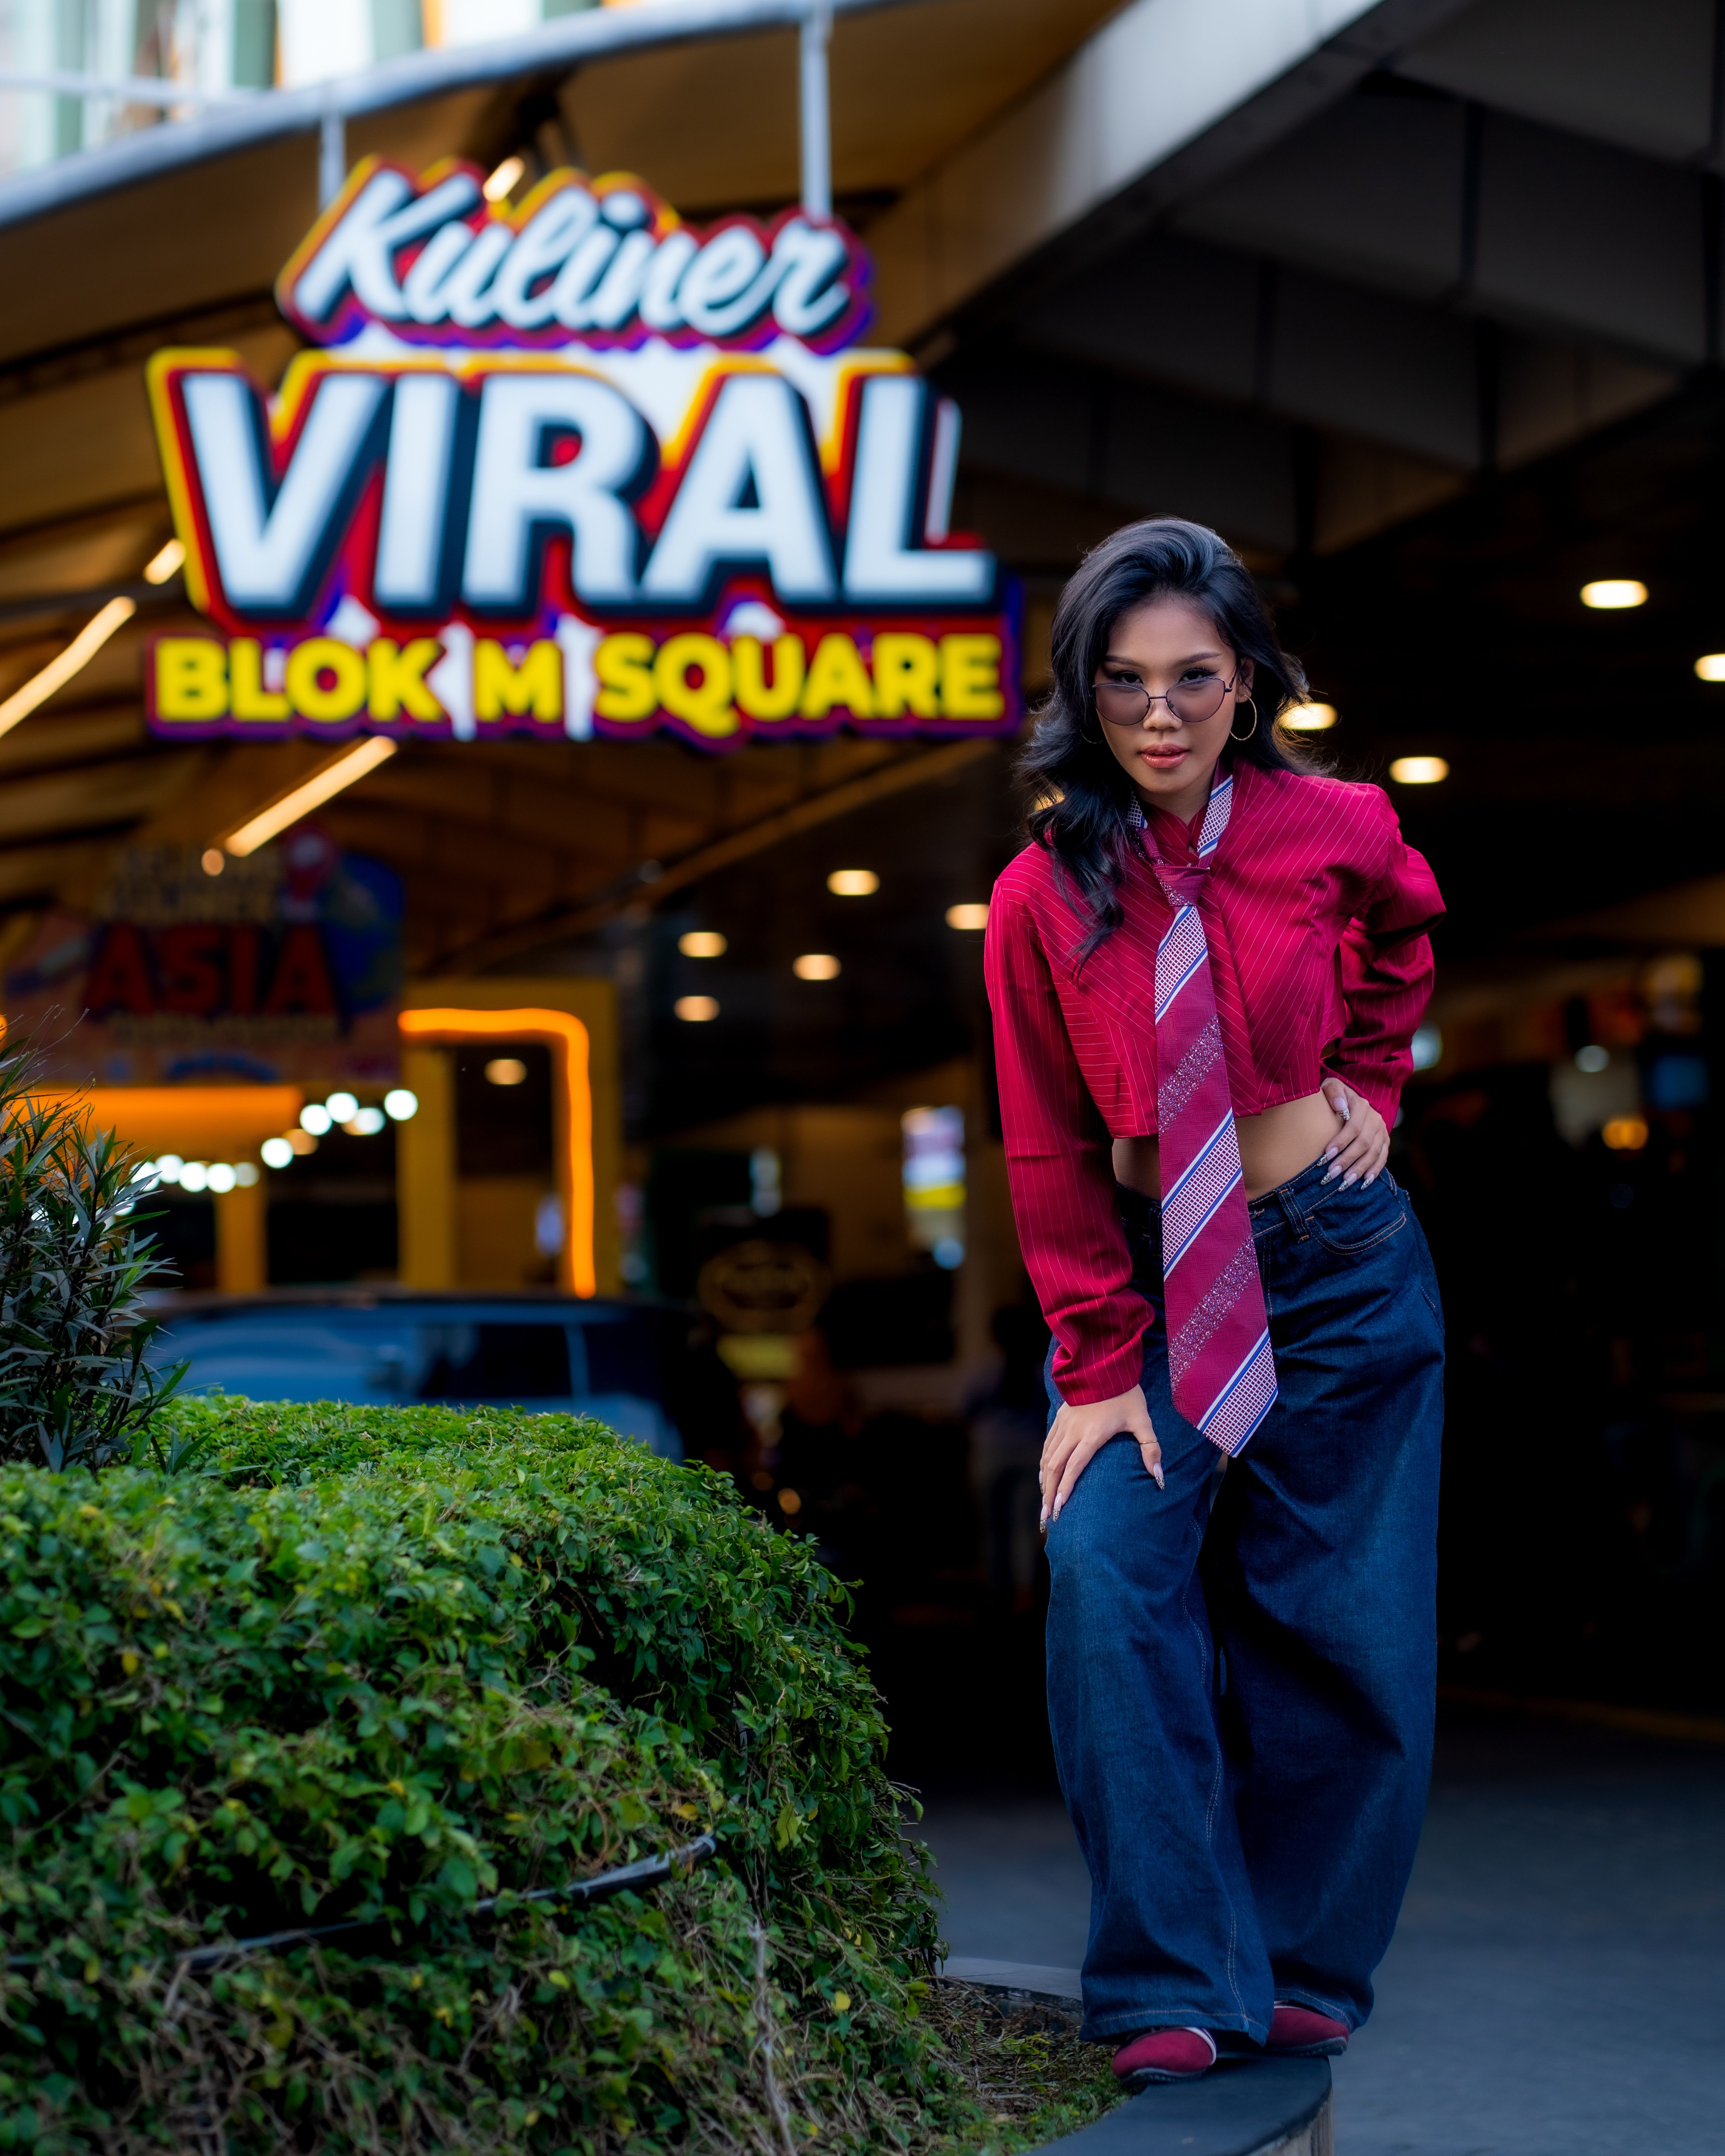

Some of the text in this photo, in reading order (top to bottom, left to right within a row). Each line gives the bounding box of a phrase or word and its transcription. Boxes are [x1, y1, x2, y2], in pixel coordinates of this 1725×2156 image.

[292, 168, 852, 337] Kuliner
[178, 369, 998, 608] VIRAL
[155, 631, 1006, 738] BLOK M SQUARE
[83, 922, 339, 1015] ASIA
